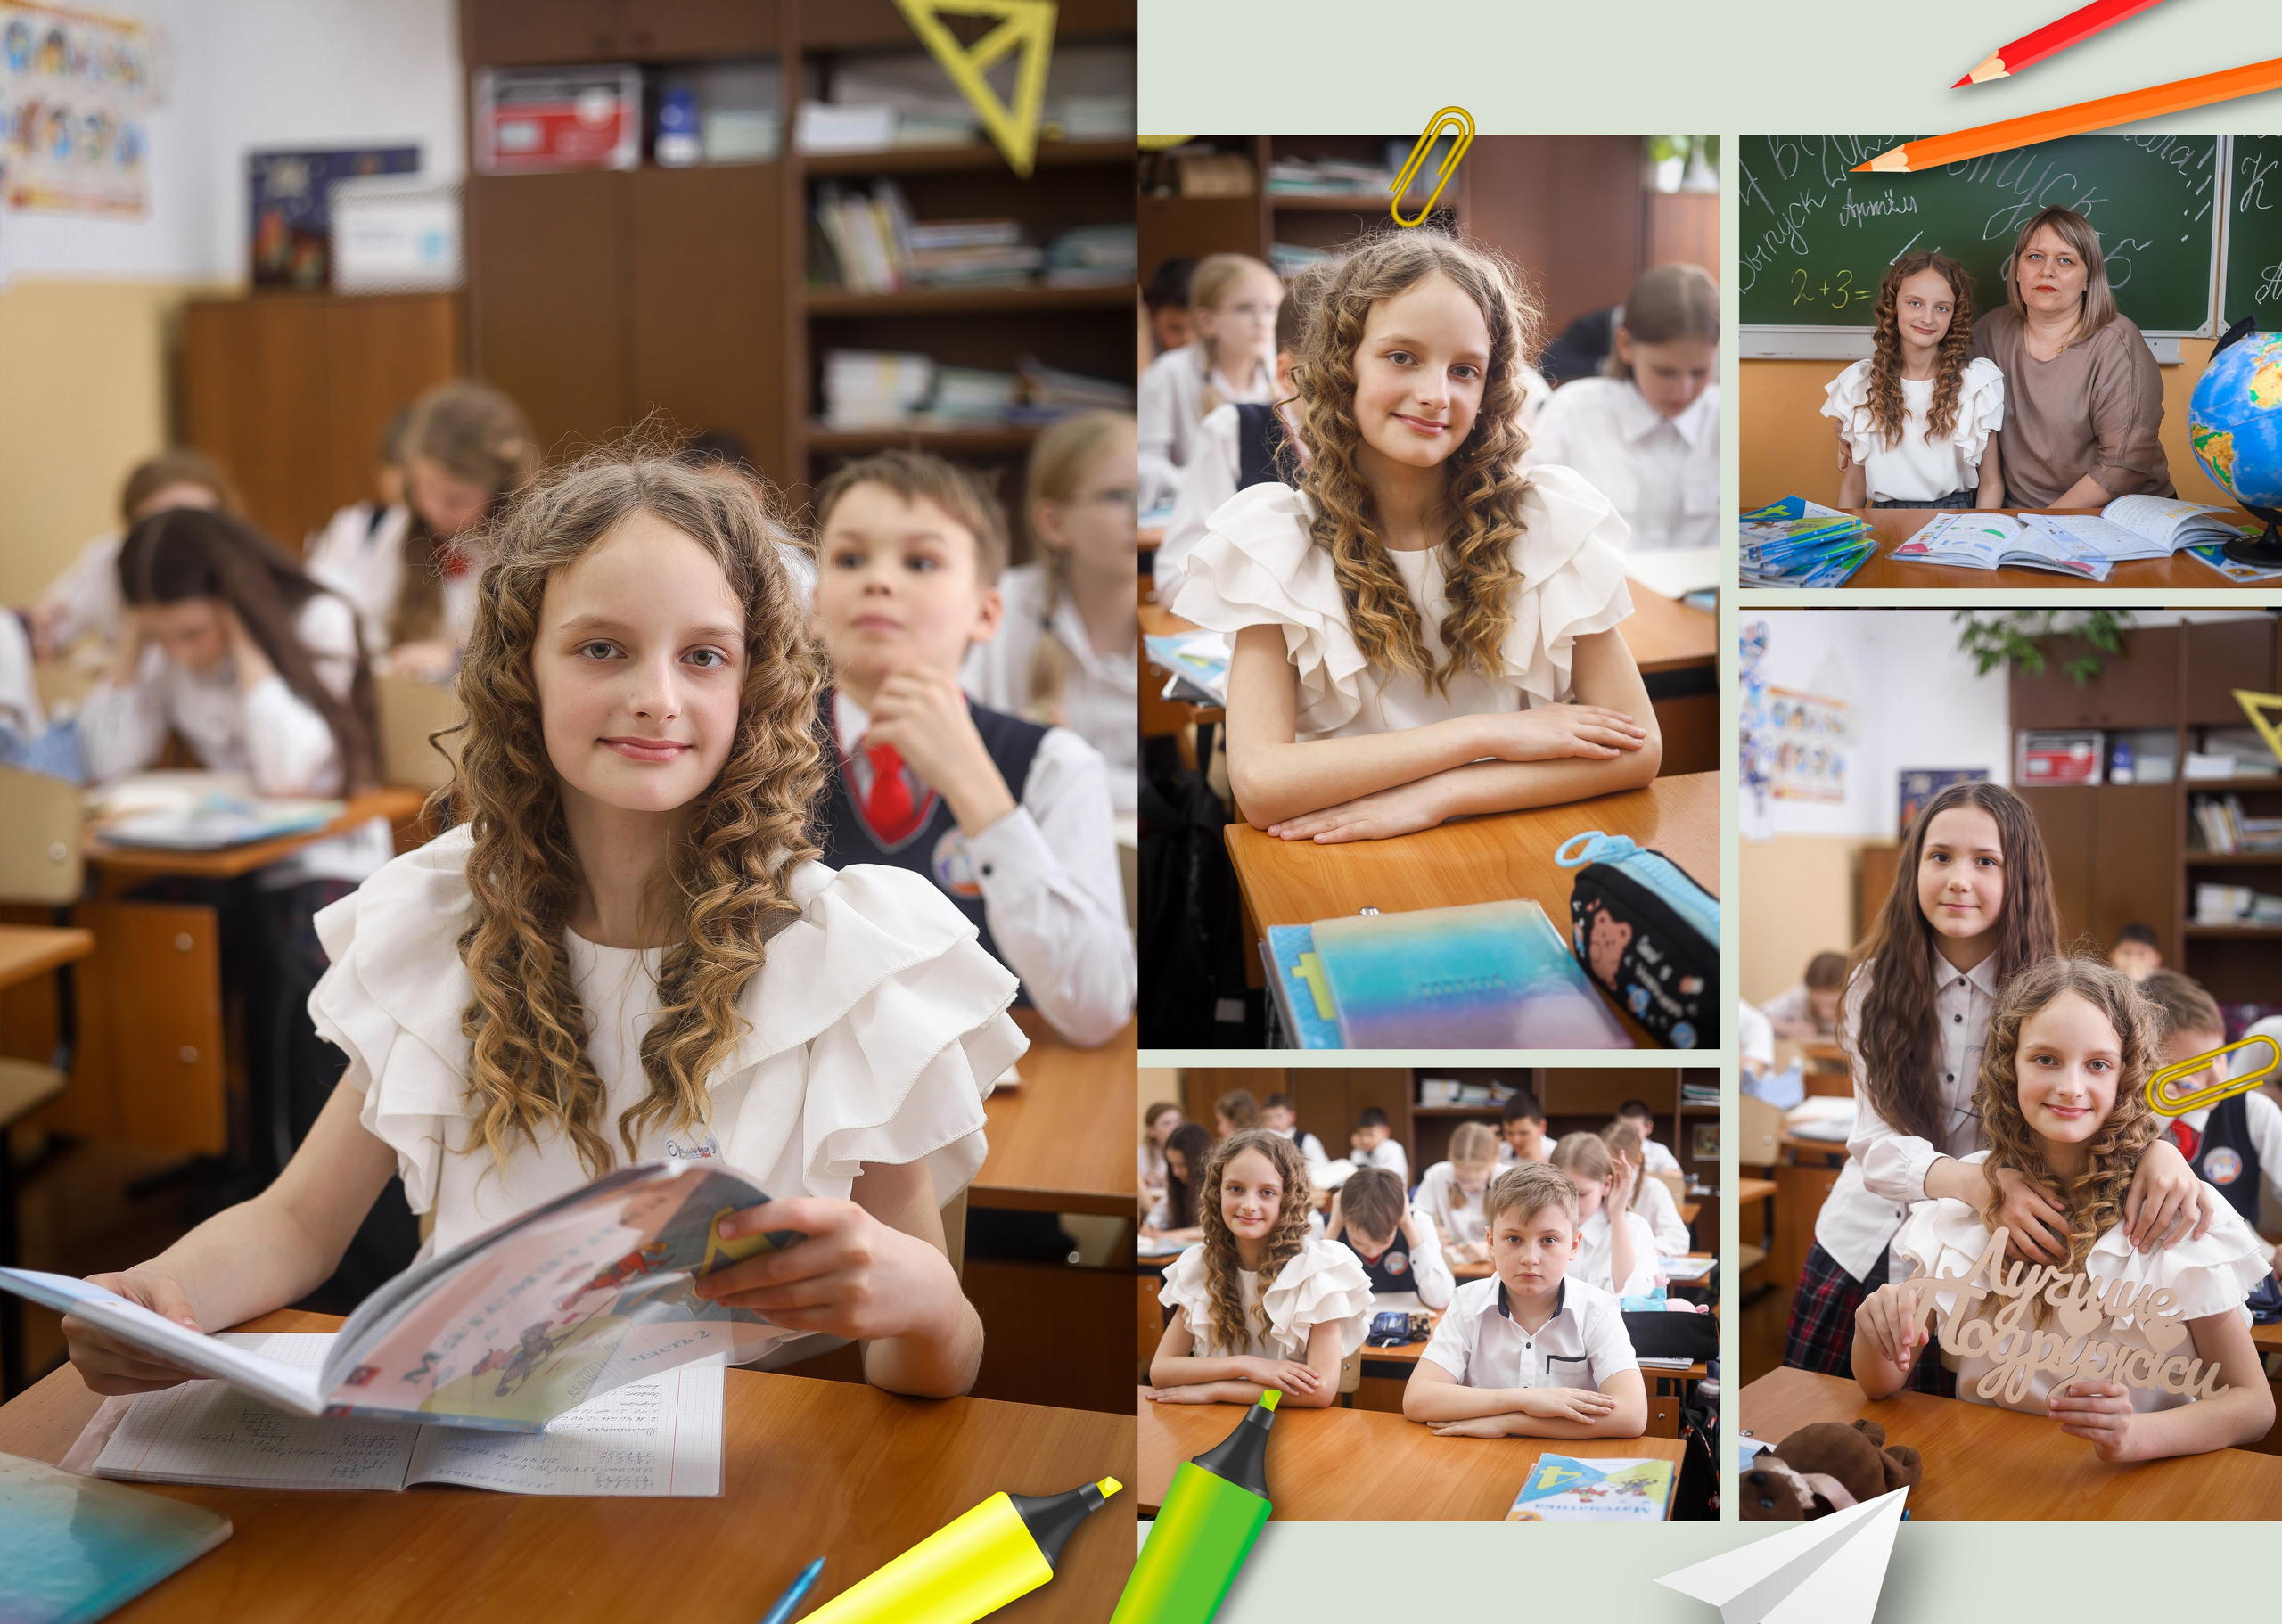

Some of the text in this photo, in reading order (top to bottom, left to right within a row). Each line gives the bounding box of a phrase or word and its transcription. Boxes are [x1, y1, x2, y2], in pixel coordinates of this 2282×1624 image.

[1839, 187, 1917, 228] Артём
[1941, 1226, 2187, 1332] Лучшие
[694, 1329, 710, 1340] 2
[1899, 1275, 2230, 1405] Подружки
[1536, 1465, 1583, 1490] 4
